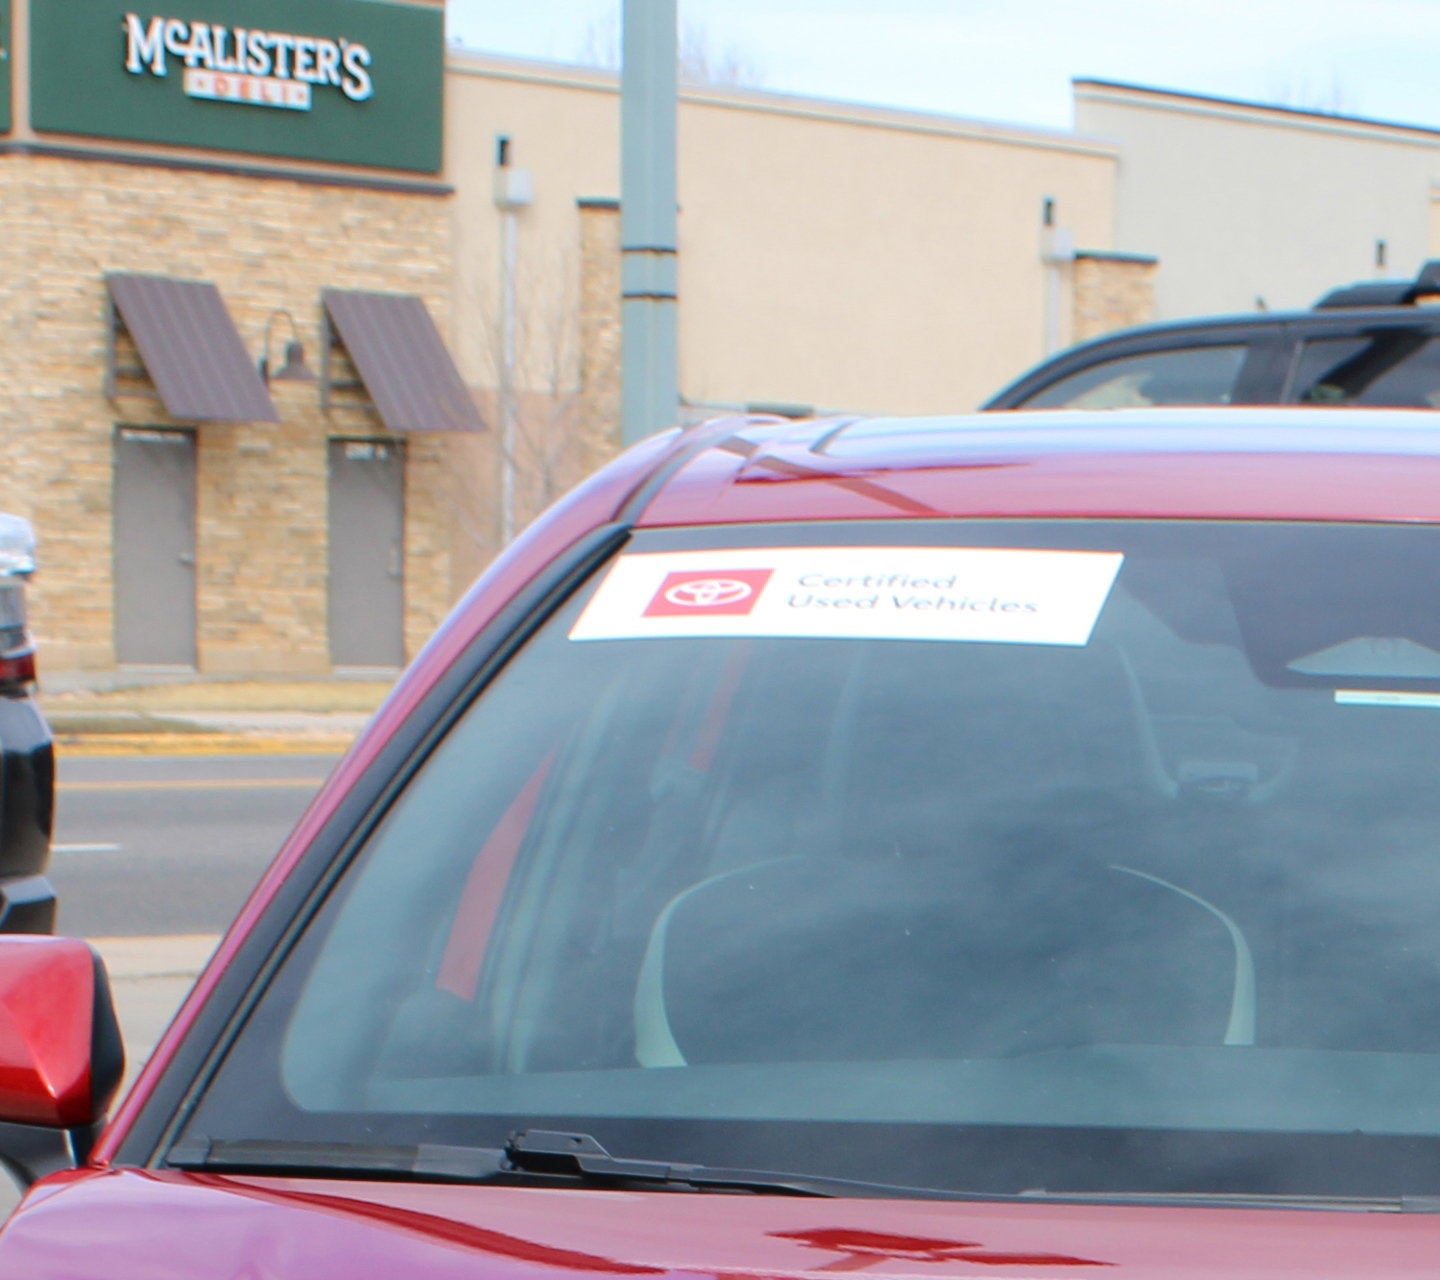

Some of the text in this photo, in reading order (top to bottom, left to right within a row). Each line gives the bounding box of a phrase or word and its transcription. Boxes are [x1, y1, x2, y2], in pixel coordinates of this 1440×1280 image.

[213, 75, 291, 105] DELI
[798, 573, 958, 590] Certified
[787, 594, 1039, 613] Used Vehicles
